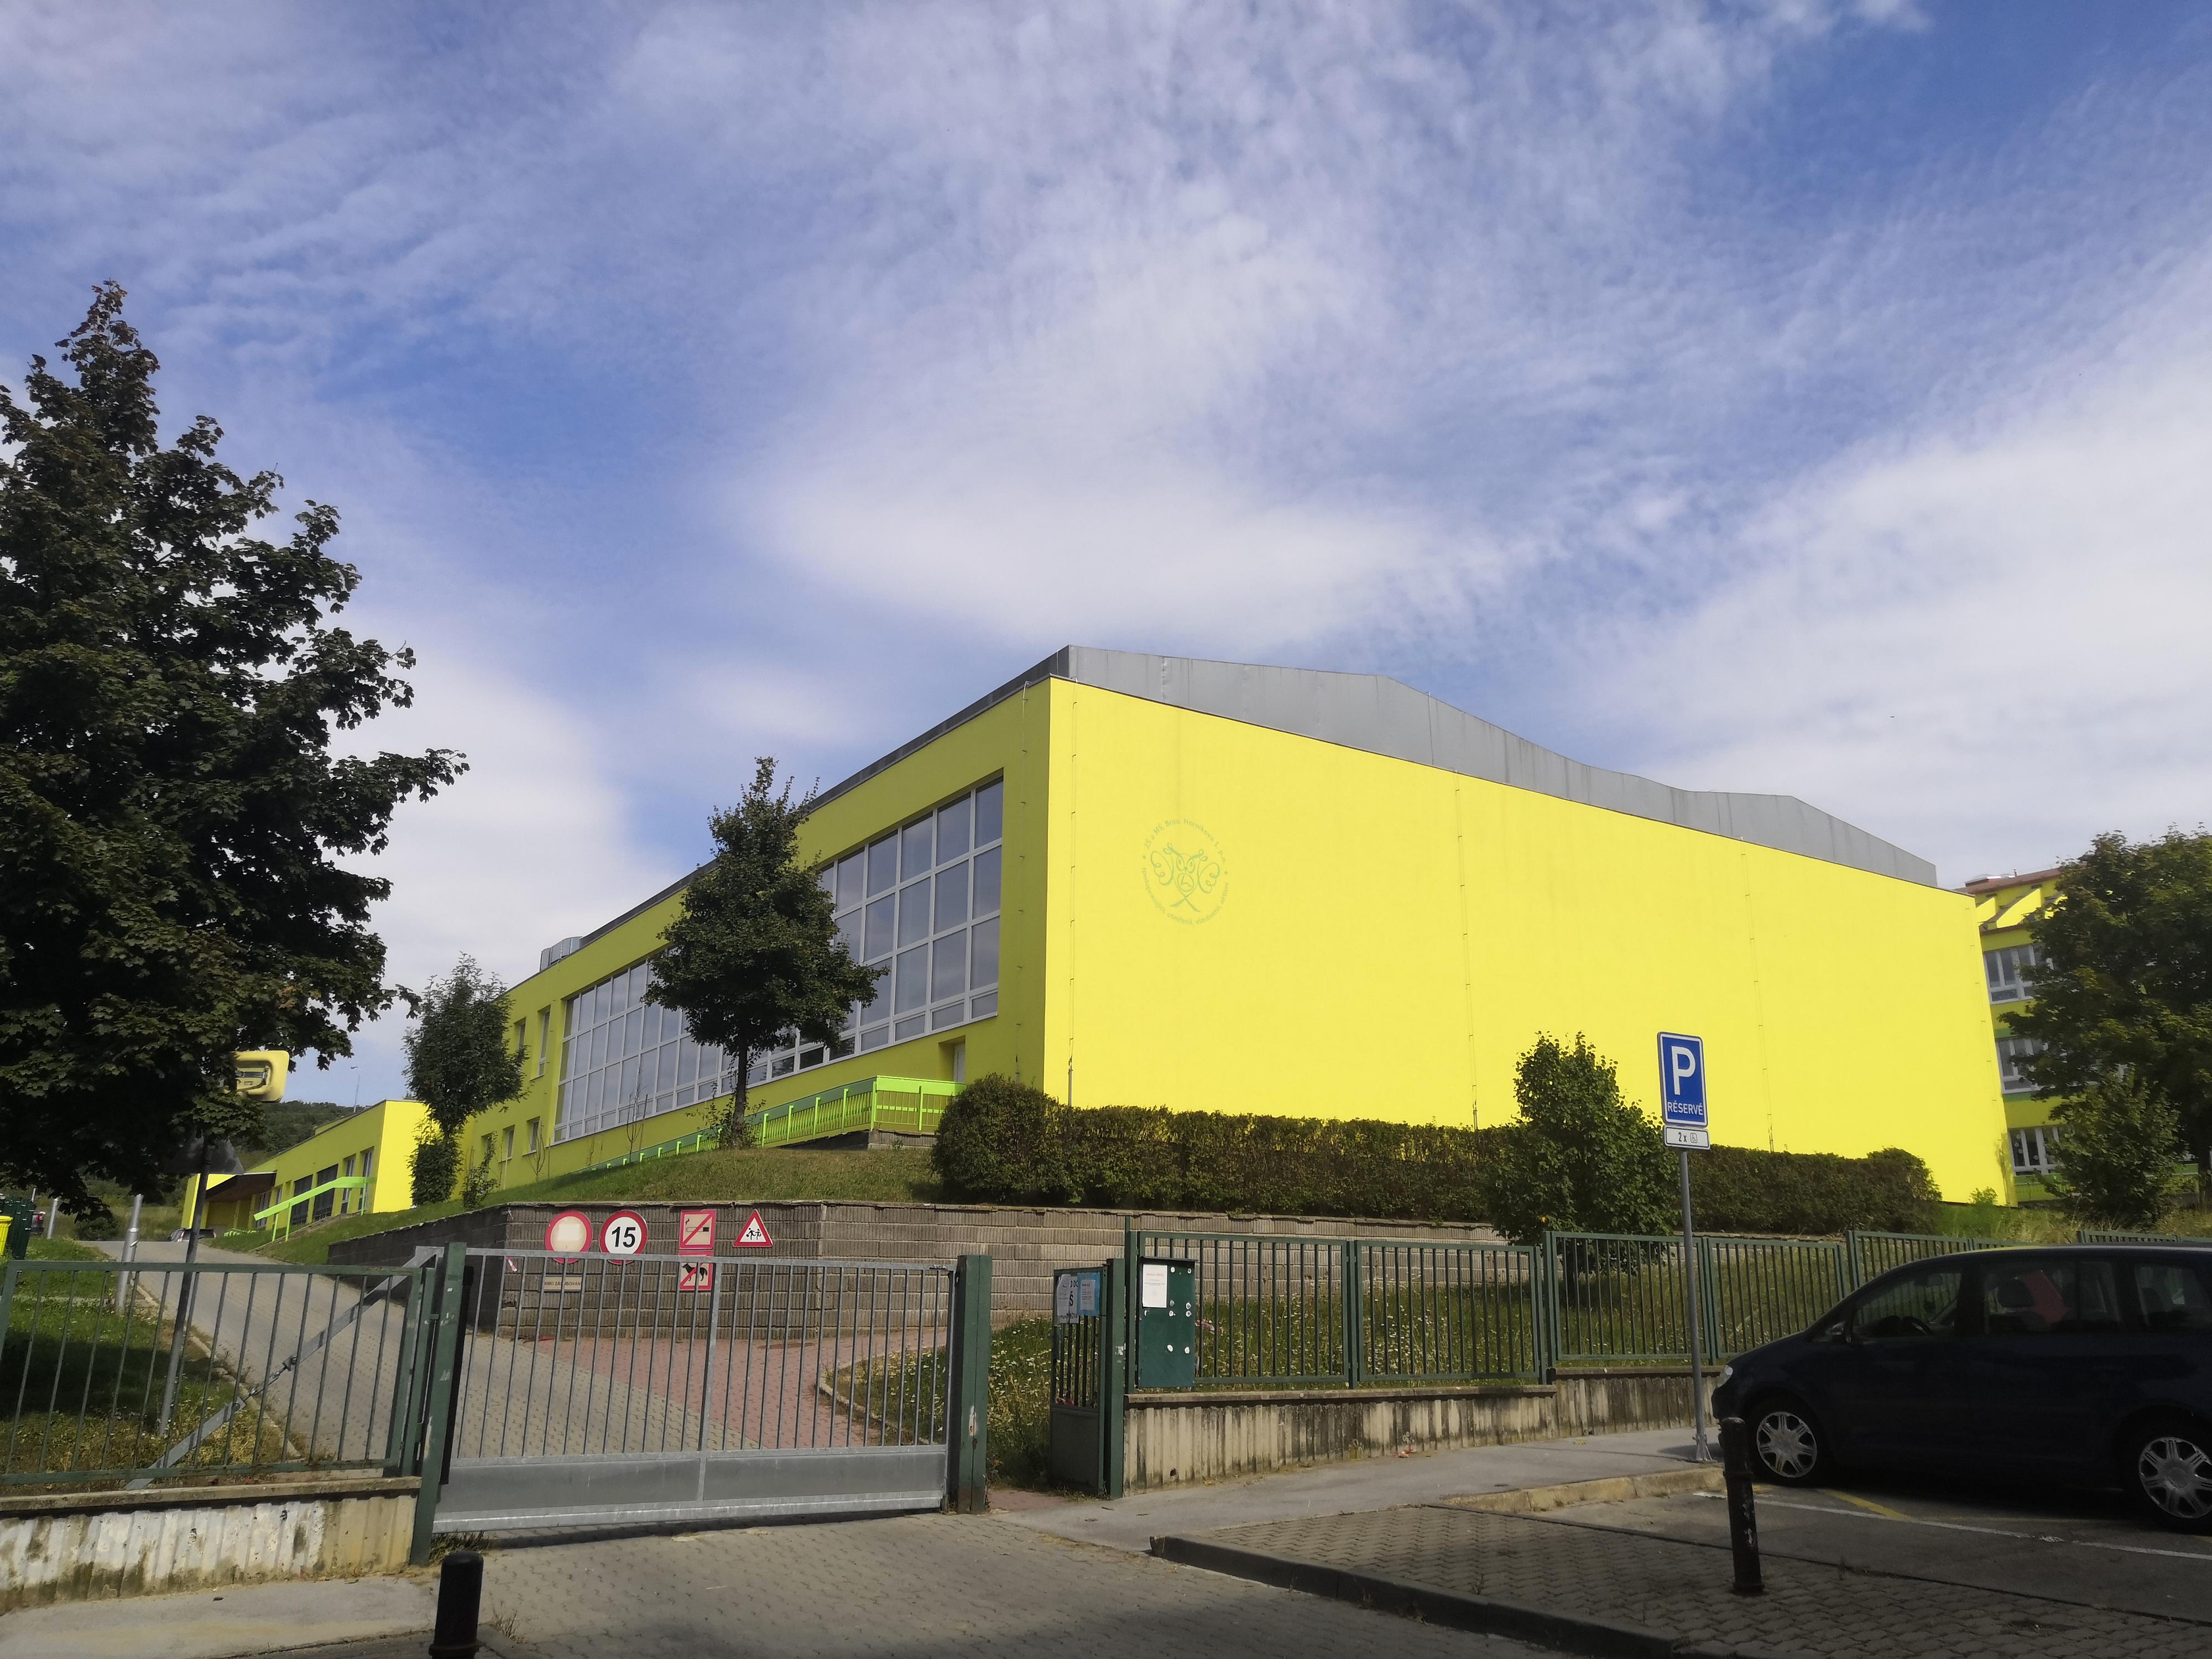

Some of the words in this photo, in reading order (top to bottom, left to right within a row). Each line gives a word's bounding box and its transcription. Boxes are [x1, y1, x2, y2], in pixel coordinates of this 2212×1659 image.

[1671, 1046, 1695, 1095] P
[1667, 1100, 1703, 1115] RÉSERVÉ
[1678, 1132, 1682, 1142] 2
[611, 1227, 636, 1248] 15
